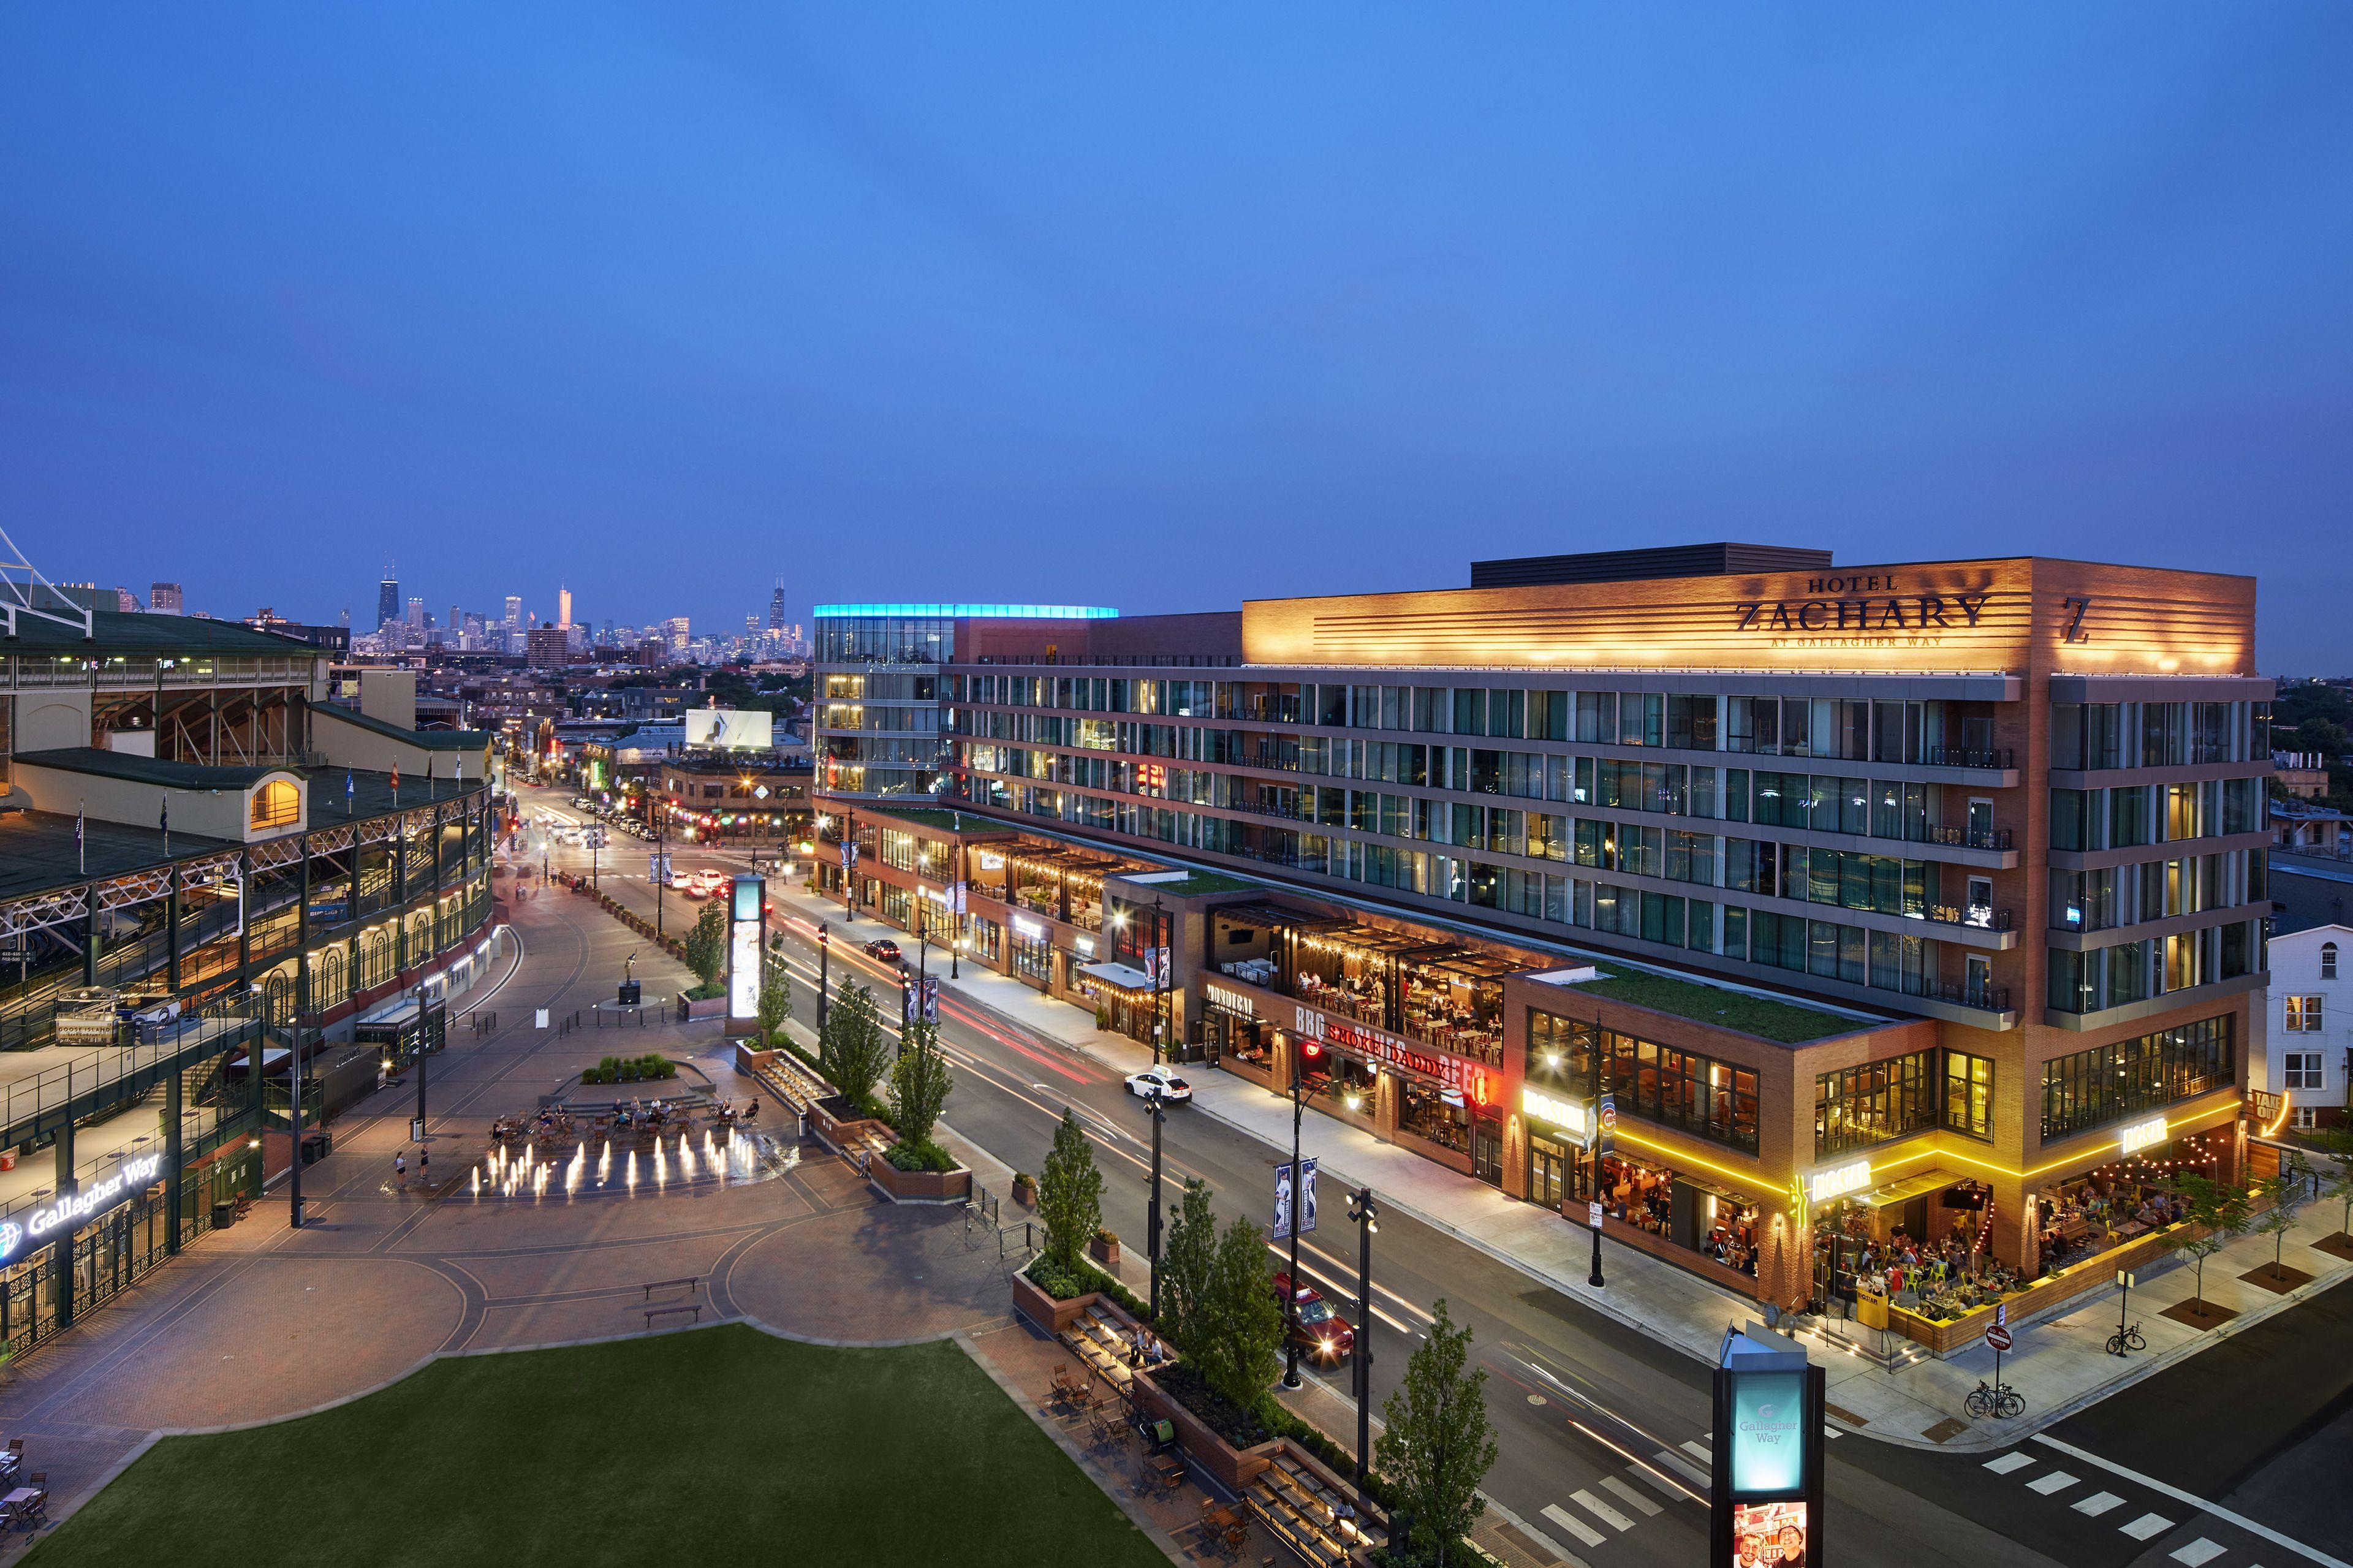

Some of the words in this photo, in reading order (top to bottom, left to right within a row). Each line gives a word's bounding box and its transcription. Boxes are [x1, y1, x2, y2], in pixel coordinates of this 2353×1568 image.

[1808, 575, 1899, 593] HOTEL
[1735, 596, 1991, 632] ZACHARY
[2063, 596, 2091, 645] Z
[1797, 638, 1896, 647] GALLAGHER
[1908, 637, 1943, 646] WAY
[1085, 973, 1119, 991] ZACHARY
[1206, 983, 1253, 1016] MORDECAI
[338, 1045, 360, 1066] DRINKS
[1296, 1006, 1325, 1040] BBQ
[1439, 1055, 1485, 1094] BEER
[1328, 1025, 1381, 1058] SMOKE
[1390, 1048, 1450, 1081] DADDY
[2256, 1092, 2281, 1110] TAKE
[2257, 1106, 2277, 1120] OUT
[28, 1173, 123, 1235] Gallagher
[123, 1153, 159, 1185] Way
[1991, 1339, 2006, 1348] ENTER
[1740, 1421, 1797, 1433] Gallagher
[1756, 1433, 1781, 1445] Way
